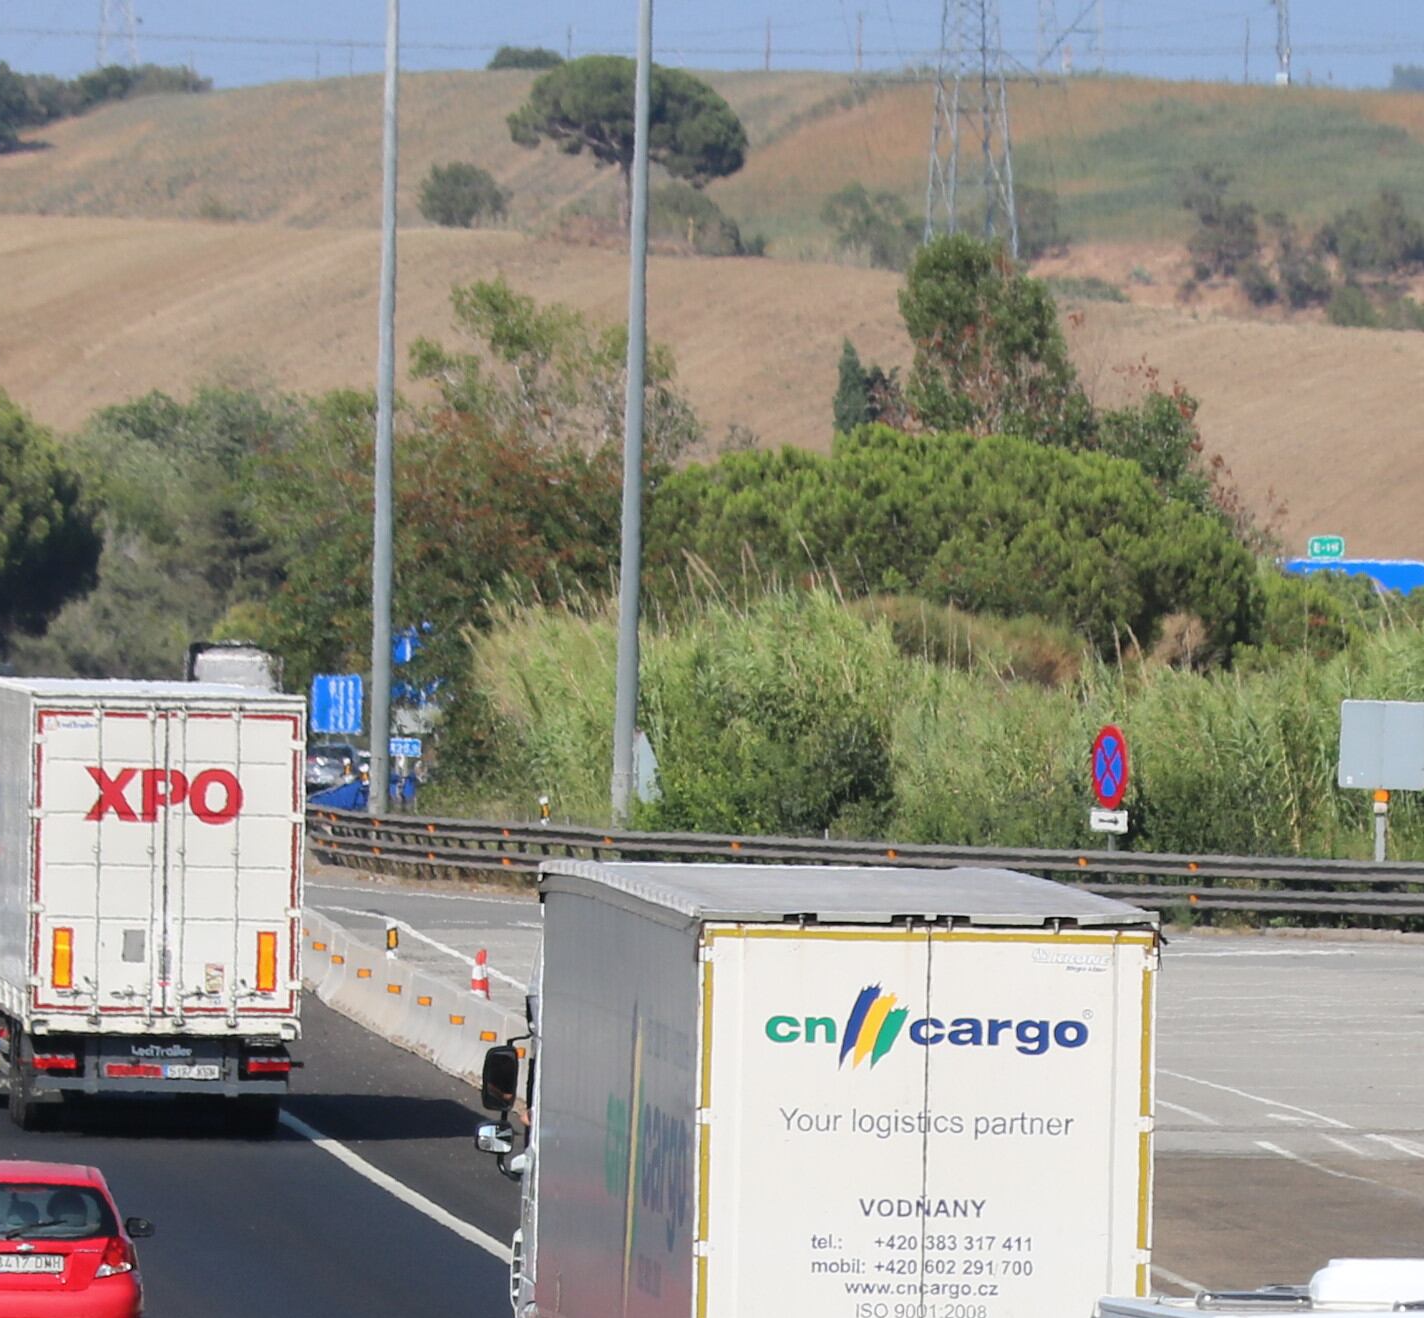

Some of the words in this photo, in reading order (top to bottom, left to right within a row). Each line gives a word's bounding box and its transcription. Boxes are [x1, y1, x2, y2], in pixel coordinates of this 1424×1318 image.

[84, 766, 243, 825] XPO
[765, 1015, 837, 1044] cn
[909, 1017, 1089, 1056] cargo
[779, 1107, 842, 1132] Your
[851, 1108, 965, 1140] logistics
[974, 1111, 1075, 1140] partner
[811, 1234, 843, 1250] tel.:
[874, 1234, 918, 1250] +420
[925, 1235, 958, 1250] 383
[963, 1235, 996, 1251] 317
[1002, 1236, 1033, 1252] 411
[811, 1258, 866, 1274] mobil:
[874, 1259, 918, 1275] +420
[924, 1259, 957, 1275] 602
[962, 1260, 994, 1276] 291
[1001, 1260, 1033, 1276] 700
[844, 1281, 1000, 1300] www.cncargo.cz
[855, 1303, 889, 1318] ISO
